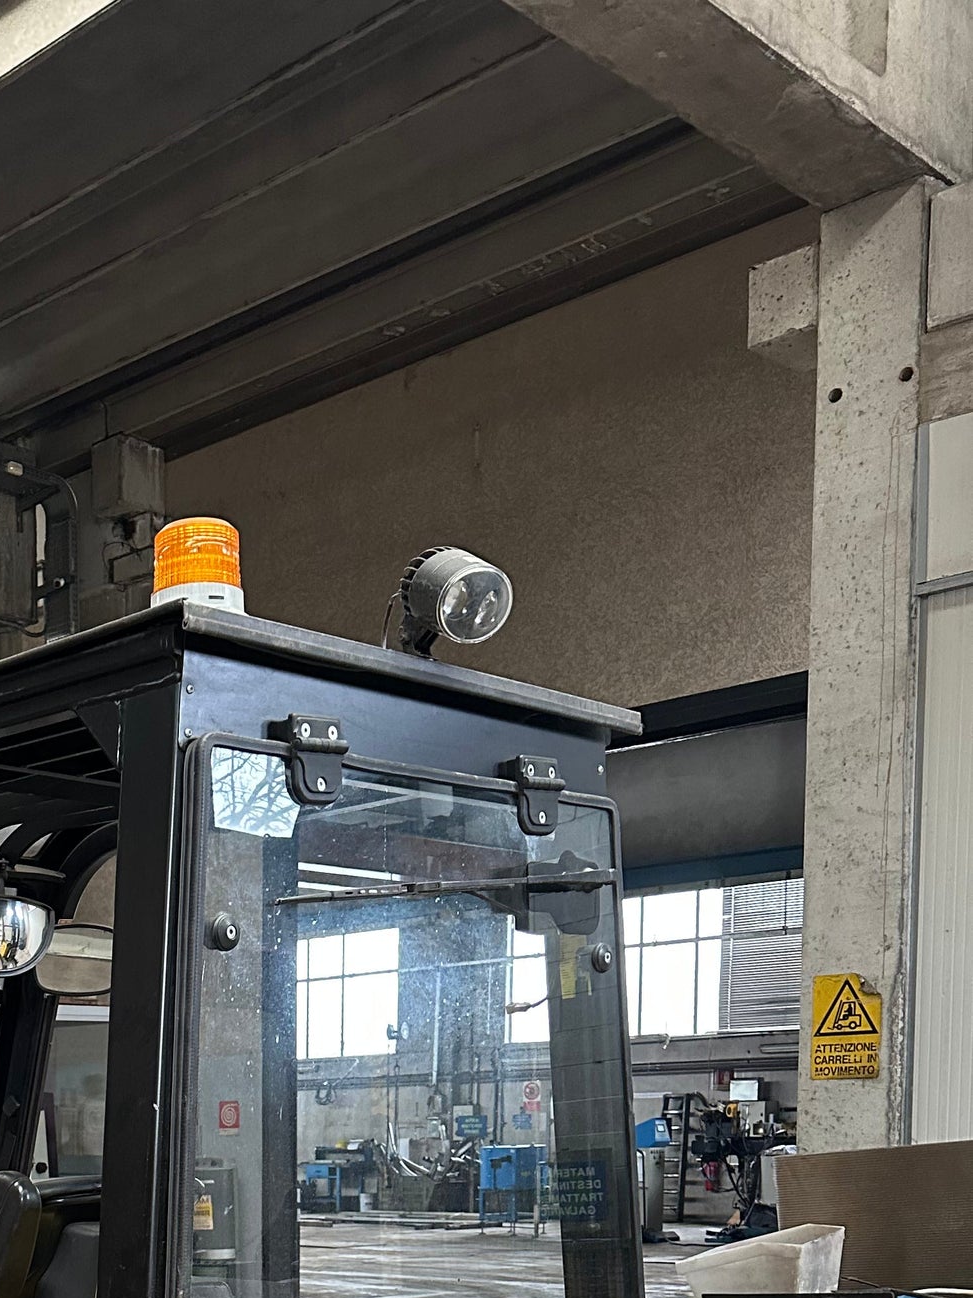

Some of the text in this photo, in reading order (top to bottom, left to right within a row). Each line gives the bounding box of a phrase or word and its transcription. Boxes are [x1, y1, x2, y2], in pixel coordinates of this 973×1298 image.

[815, 1042, 877, 1054] ATTENZIONE
[814, 1053, 877, 1065] CARRELLI IN
[814, 1065, 875, 1077] MOVIMENTO
